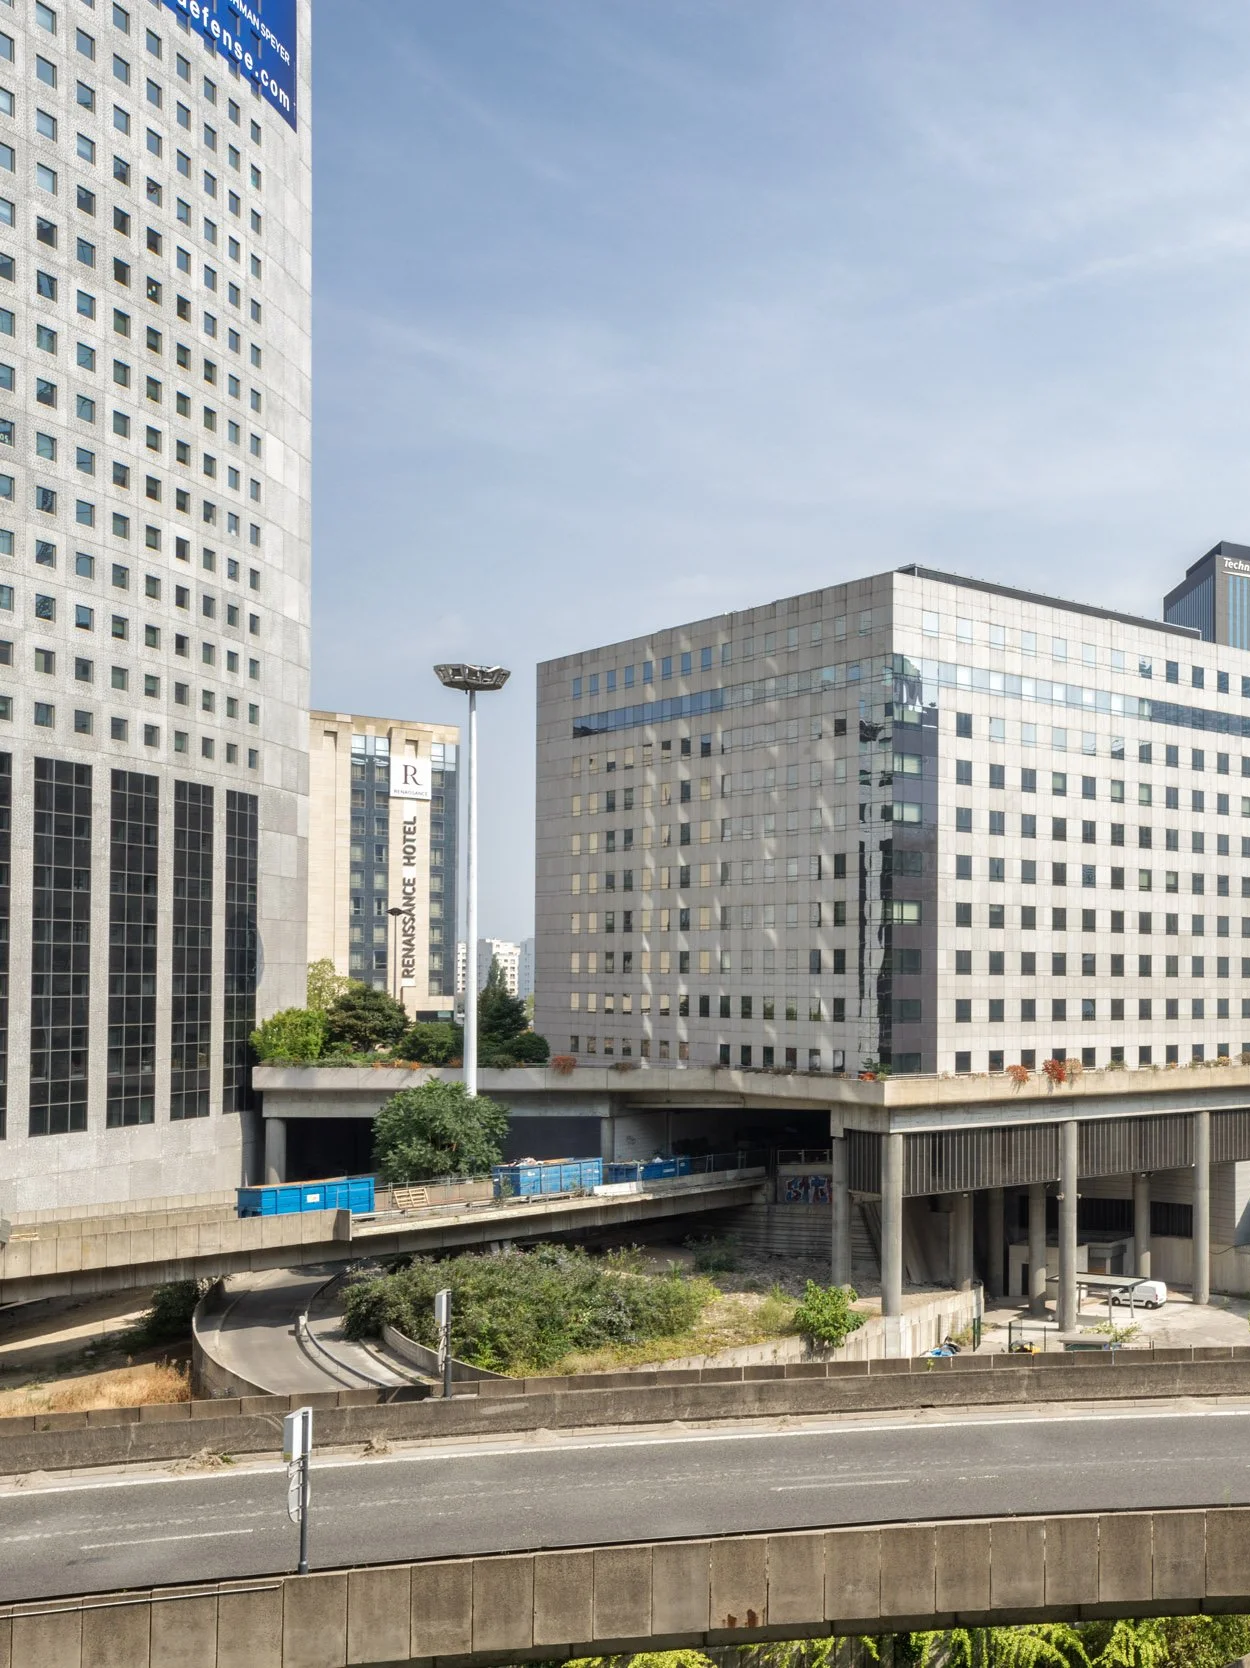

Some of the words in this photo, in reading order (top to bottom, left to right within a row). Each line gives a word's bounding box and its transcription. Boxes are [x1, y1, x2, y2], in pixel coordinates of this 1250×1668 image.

[260, 23, 290, 66] SPEYER
[402, 764, 423, 786] R
[403, 816, 417, 866] HOTEL
[401, 877, 416, 979] RENAISSANCE
